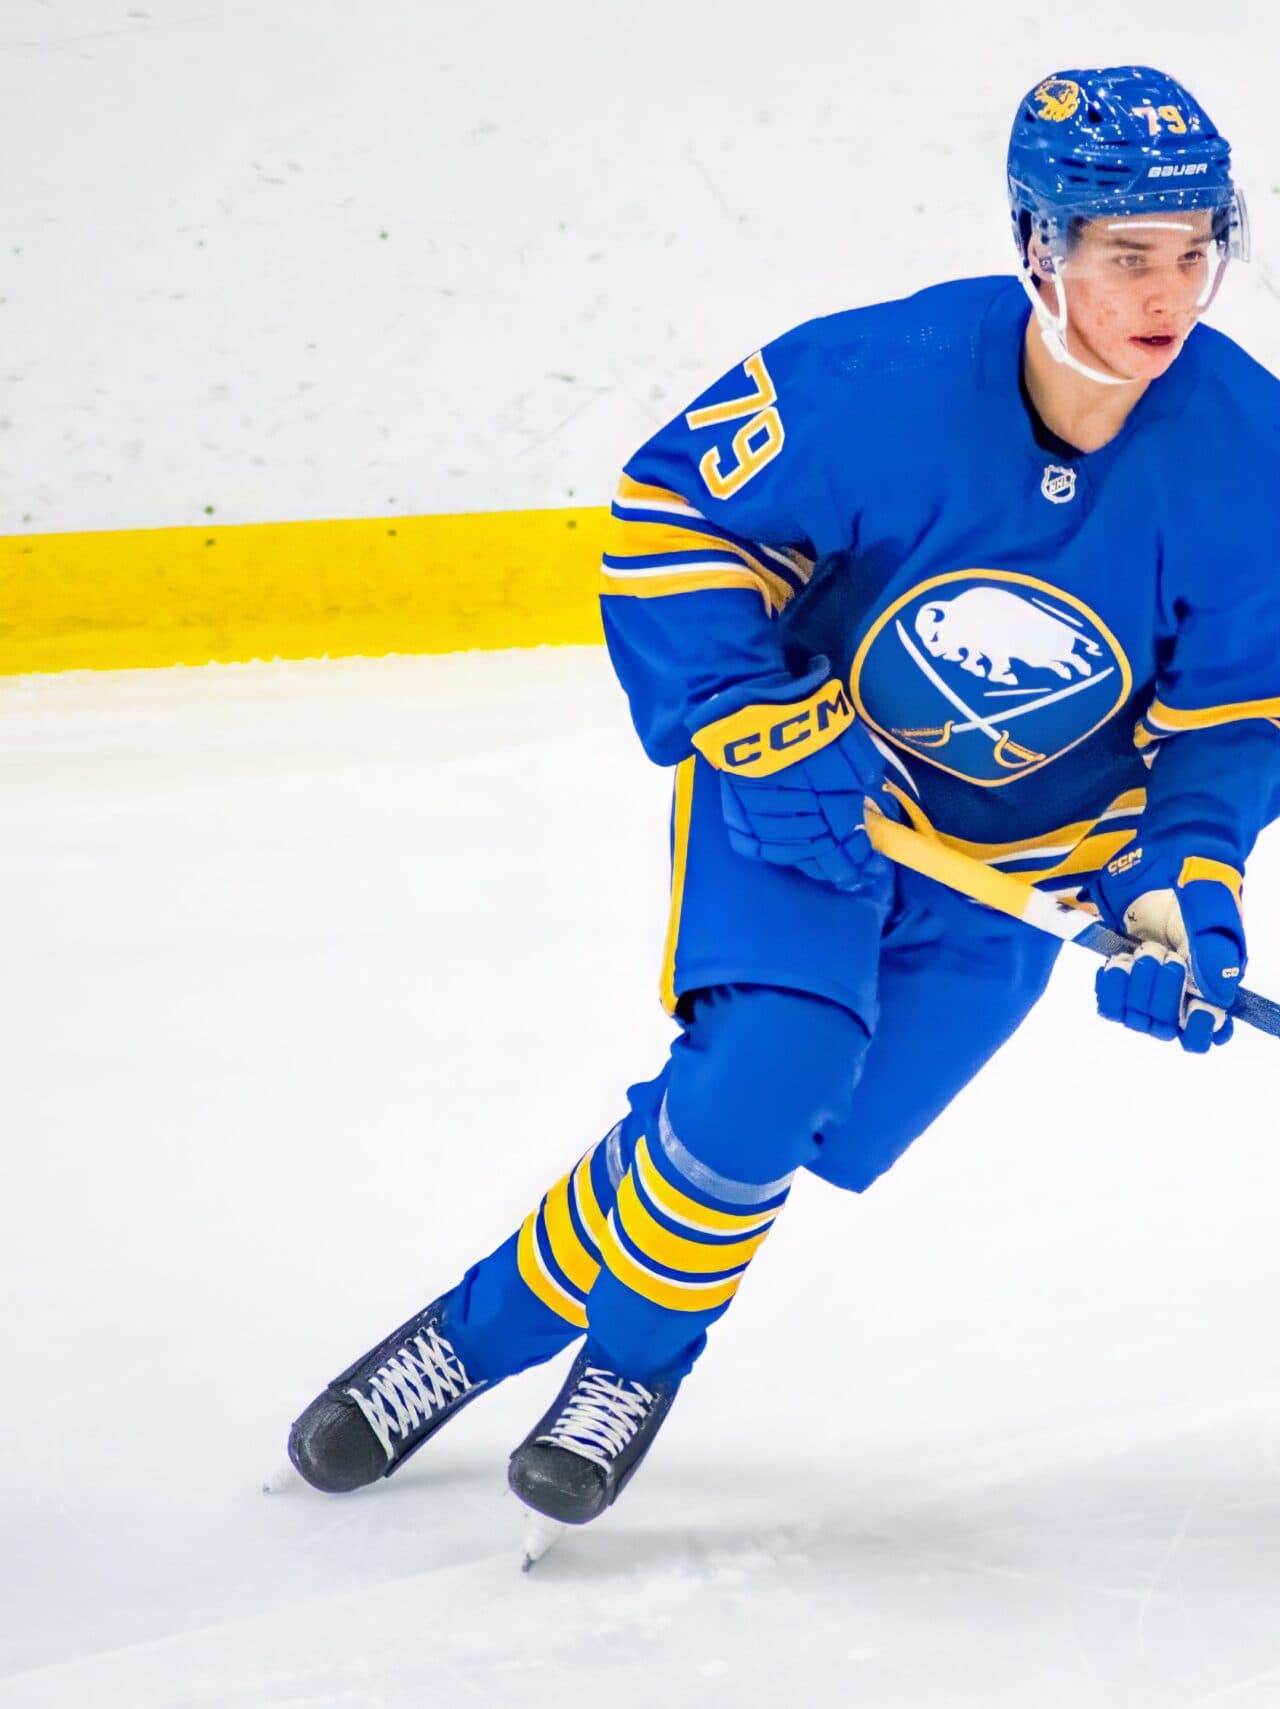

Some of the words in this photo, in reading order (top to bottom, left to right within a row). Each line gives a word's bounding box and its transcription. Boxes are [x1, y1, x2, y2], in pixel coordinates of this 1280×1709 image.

[1132, 105, 1187, 136] 79
[1147, 163, 1208, 178] BAUER
[685, 350, 785, 500] 79
[724, 690, 850, 767] CCM
[1108, 847, 1143, 873] CCM
